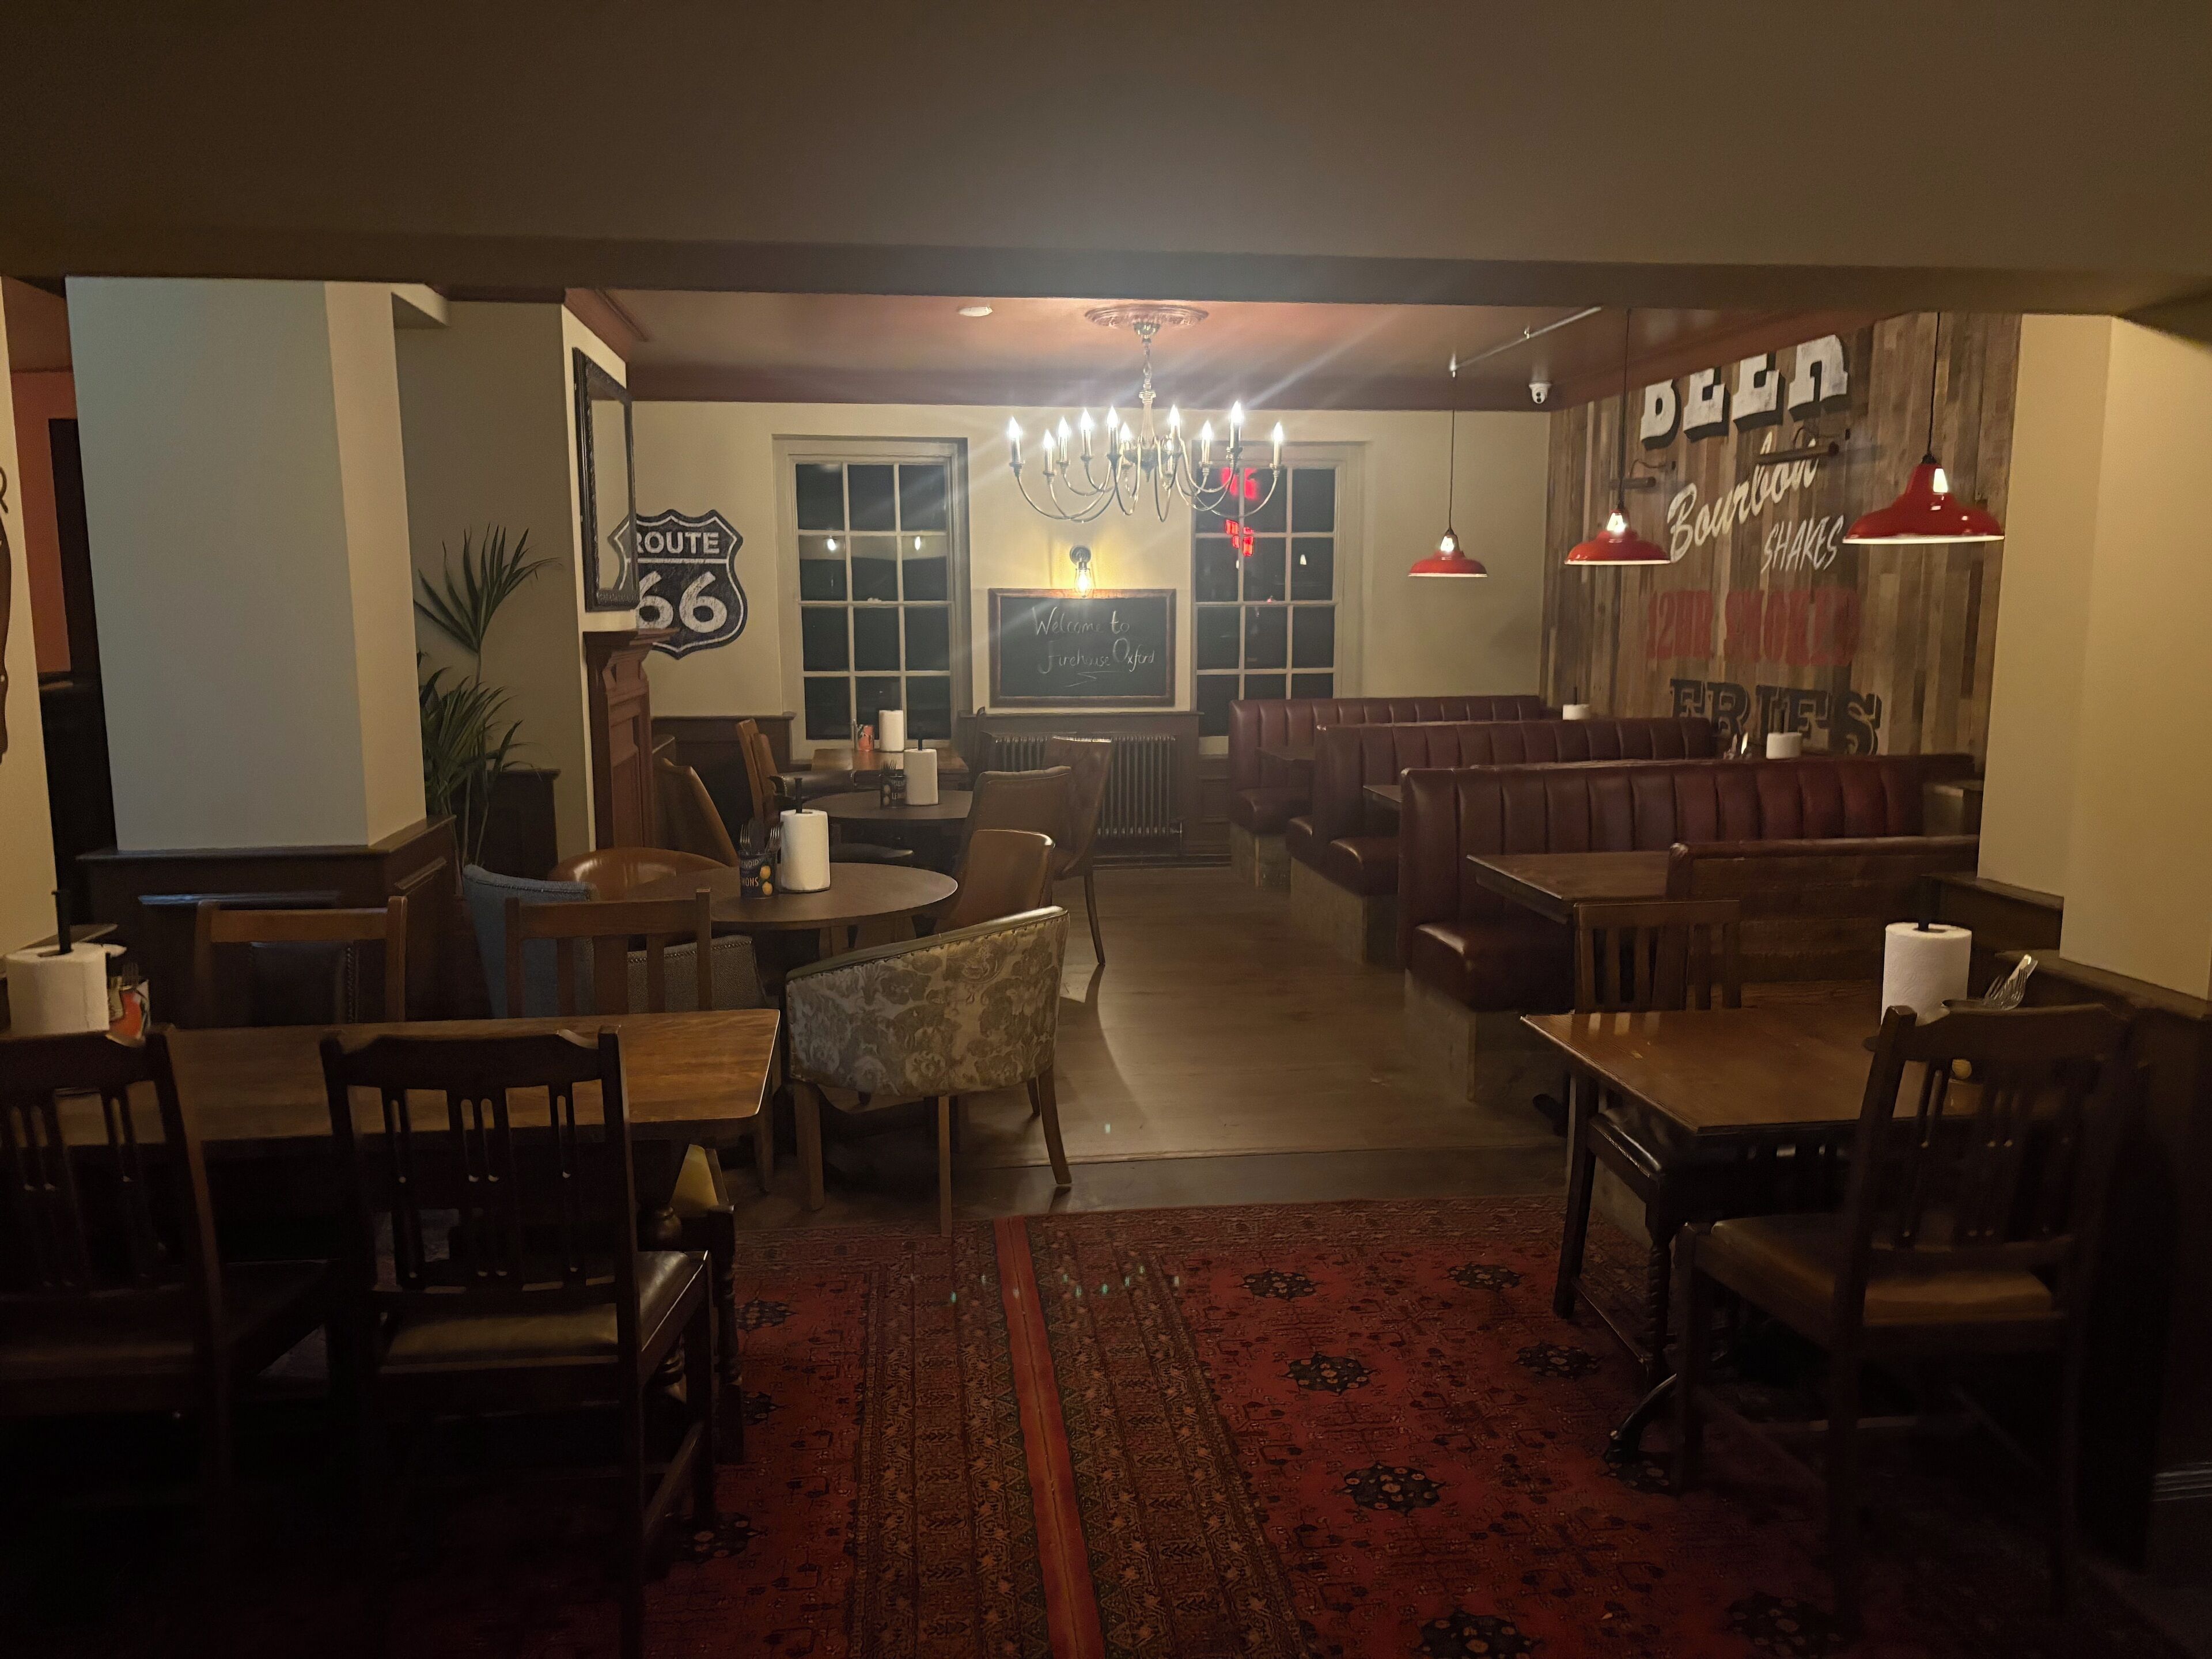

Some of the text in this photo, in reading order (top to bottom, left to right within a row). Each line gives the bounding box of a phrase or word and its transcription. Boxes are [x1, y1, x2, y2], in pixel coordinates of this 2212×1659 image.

[1667, 431, 1819, 563] Bourbon
[1760, 515, 1844, 574] SHAKES
[636, 571, 727, 633] 66
[1032, 607, 1130, 635] Welcome to
[1038, 638, 1155, 674] Firehouse Oxford
[1670, 679, 1883, 756] FRIES
